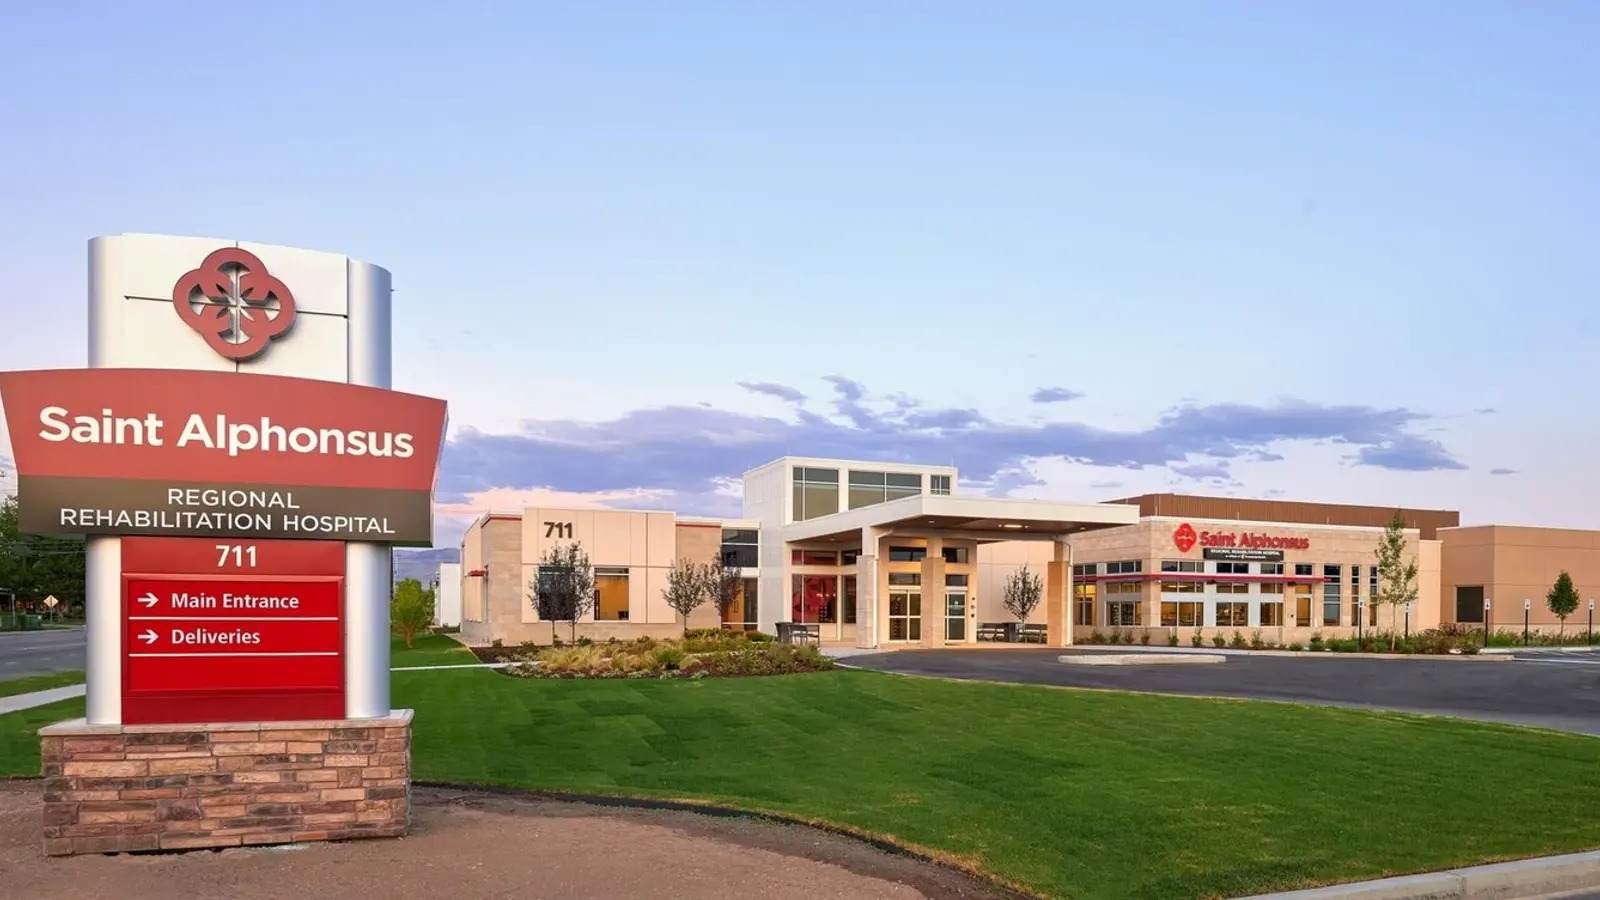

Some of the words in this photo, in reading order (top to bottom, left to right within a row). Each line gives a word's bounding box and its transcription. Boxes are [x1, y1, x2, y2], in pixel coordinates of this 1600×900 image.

[38, 405, 163, 447] Saint
[176, 413, 414, 459] Alphonsus
[167, 488, 300, 509] REGIONAL
[60, 508, 272, 532] REHABILITATION
[283, 516, 396, 535] HOSPITAL
[543, 521, 573, 539] 711
[1200, 531, 1236, 547] Saint
[1239, 532, 1309, 549] Alphonsus
[215, 544, 257, 568] 711
[171, 592, 217, 609] Main
[222, 593, 300, 610] Entrance
[171, 628, 261, 645] Deliveries
